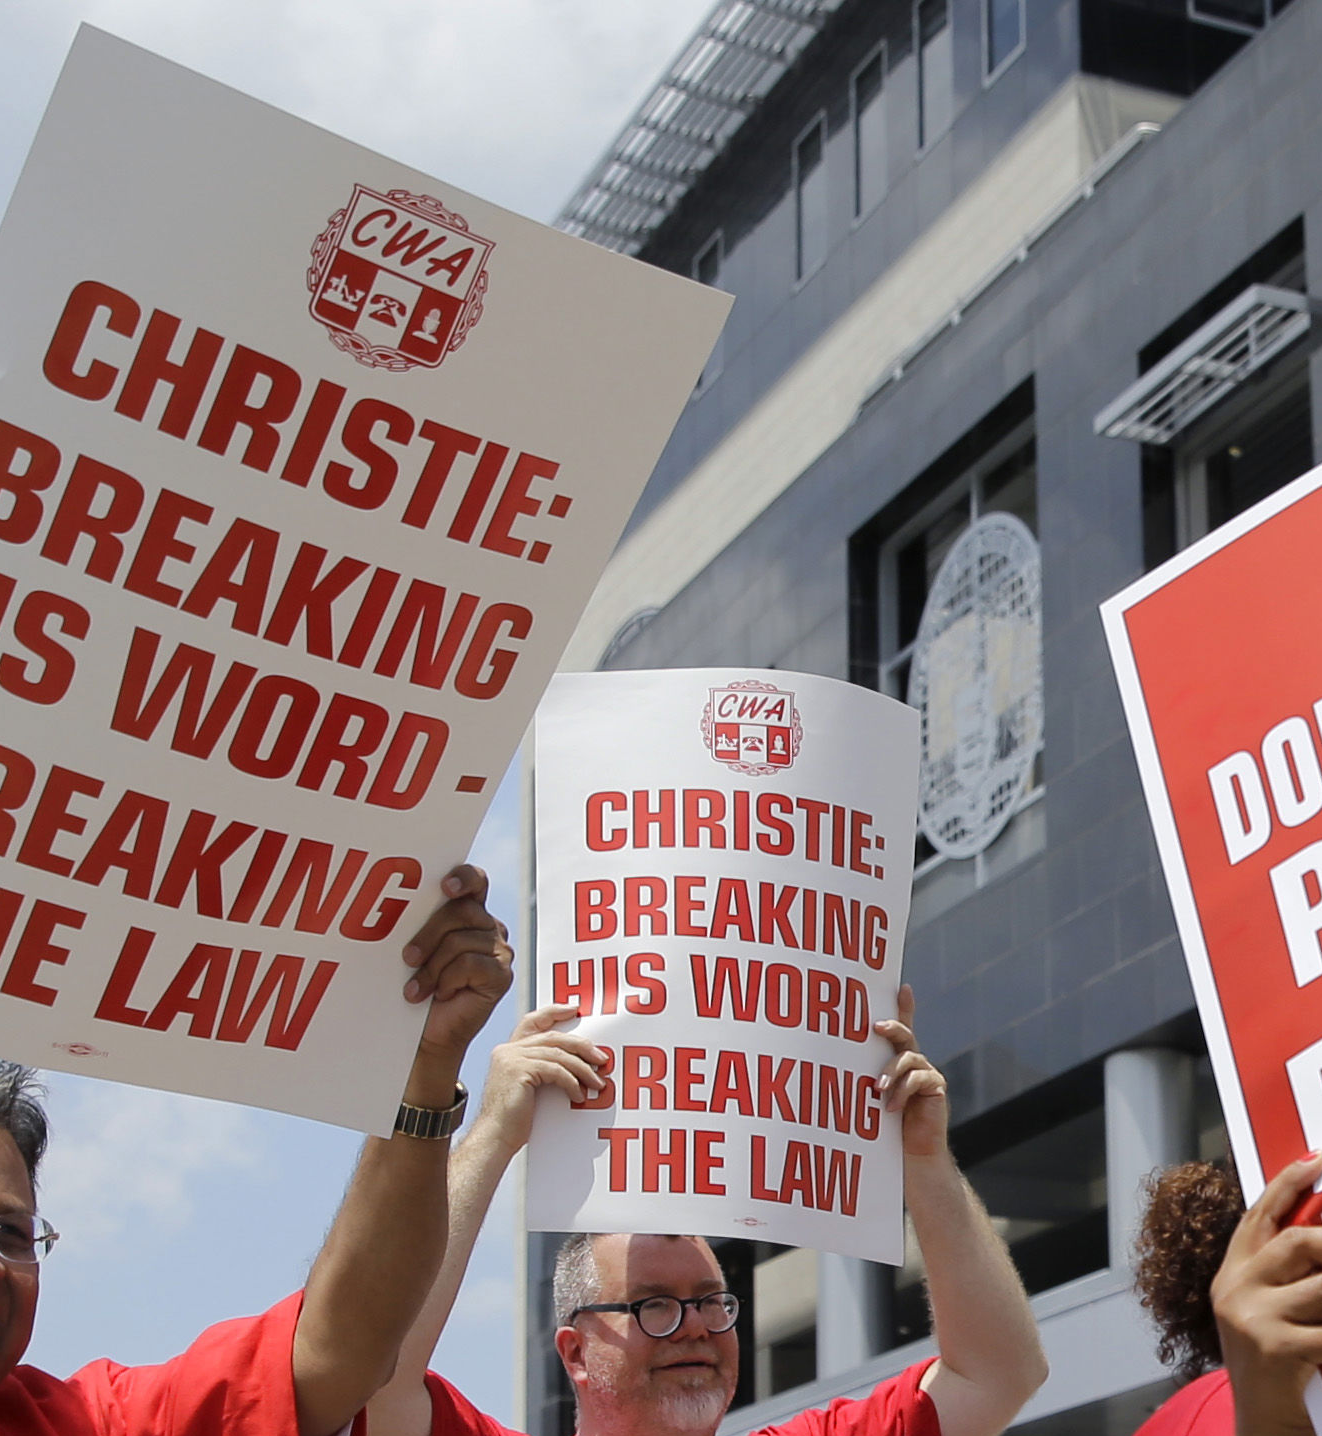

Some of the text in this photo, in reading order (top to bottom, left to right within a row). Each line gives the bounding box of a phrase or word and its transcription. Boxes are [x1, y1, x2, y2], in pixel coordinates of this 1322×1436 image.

[349, 205, 475, 290] CWA
[42, 279, 573, 565] CHRISTIE:
[110, 628, 450, 811] WORD
[717, 692, 787, 723] CWA
[584, 788, 885, 880] CHRISTIE:
[574, 874, 889, 971] BREAKING
[95, 927, 339, 1052] LAW
[551, 952, 870, 1043] HIS WORD
[570, 1045, 882, 1141] BREAKING
[598, 1127, 862, 1217] THE LAW
